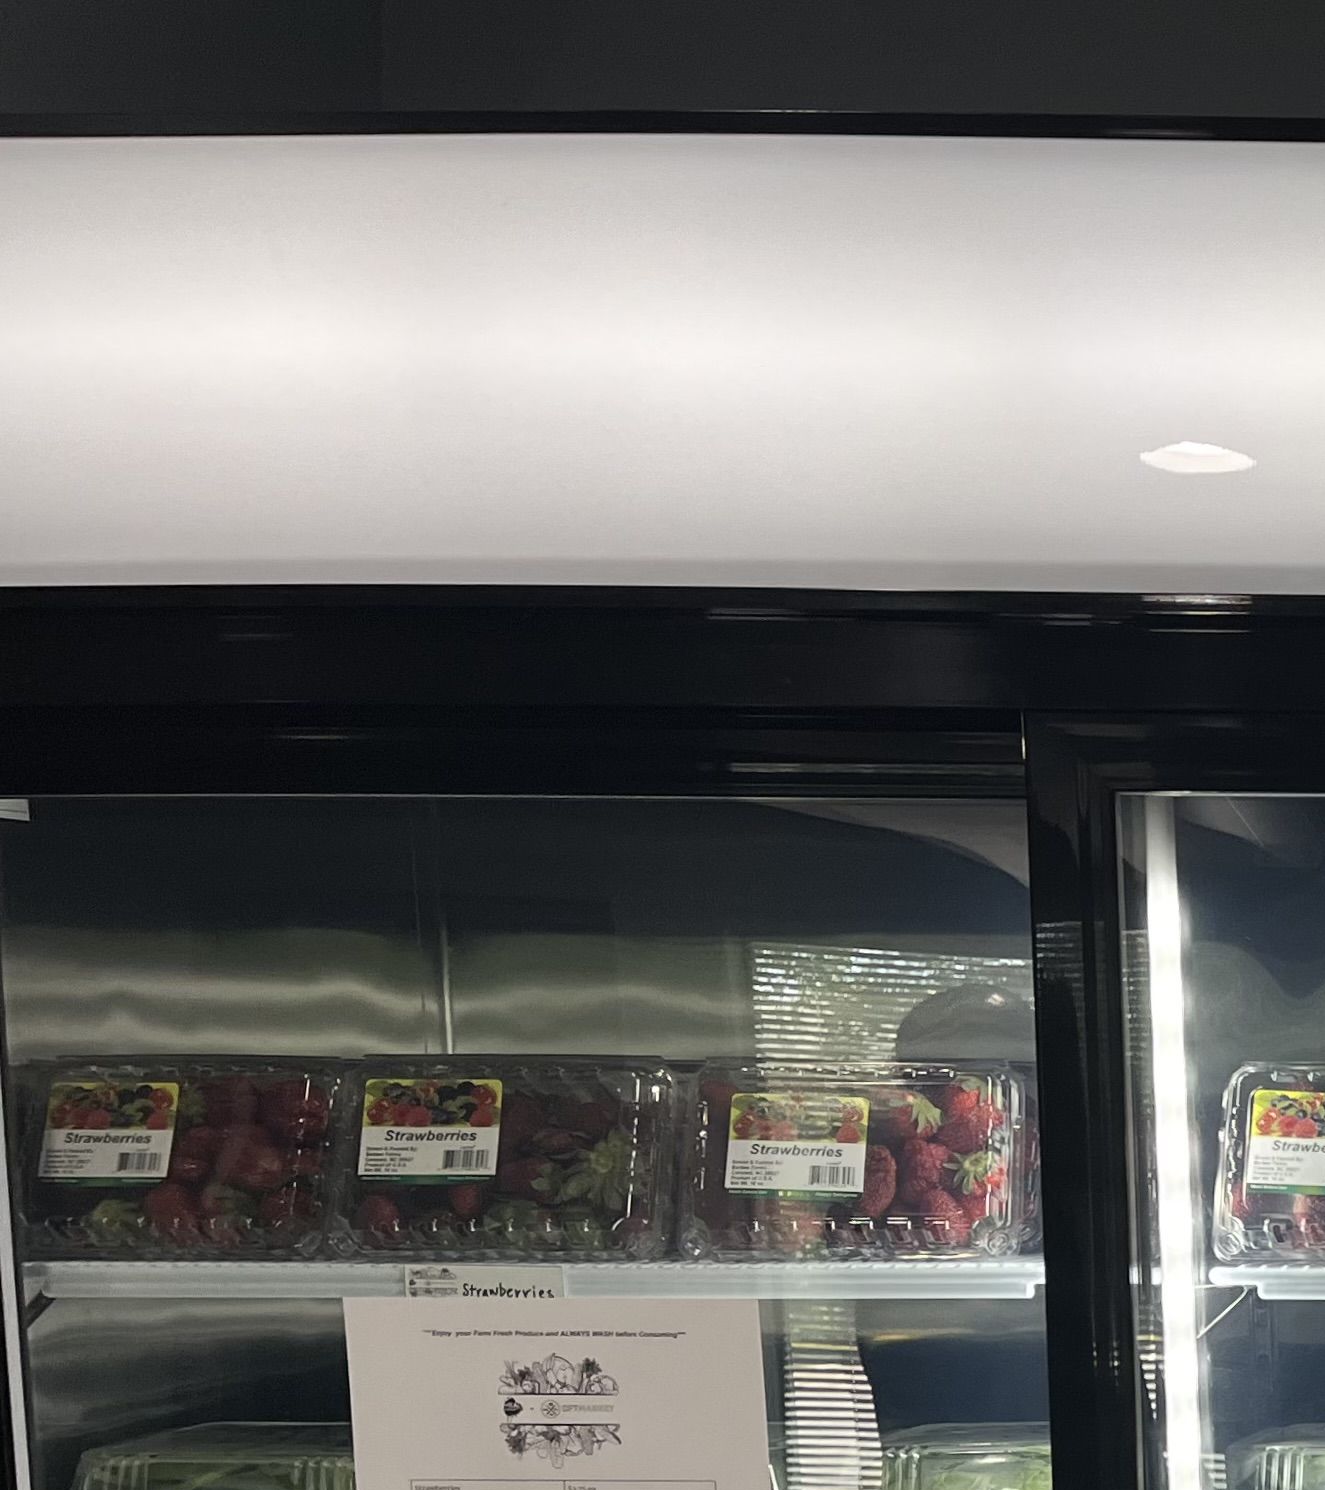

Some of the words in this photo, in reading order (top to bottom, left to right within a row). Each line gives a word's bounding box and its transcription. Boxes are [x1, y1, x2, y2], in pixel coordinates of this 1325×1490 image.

[64, 1132, 152, 1144] Strawberries
[384, 1130, 477, 1142] Strawberries
[751, 1144, 842, 1158] Strawberries
[463, 1282, 555, 1299] Strawberries
